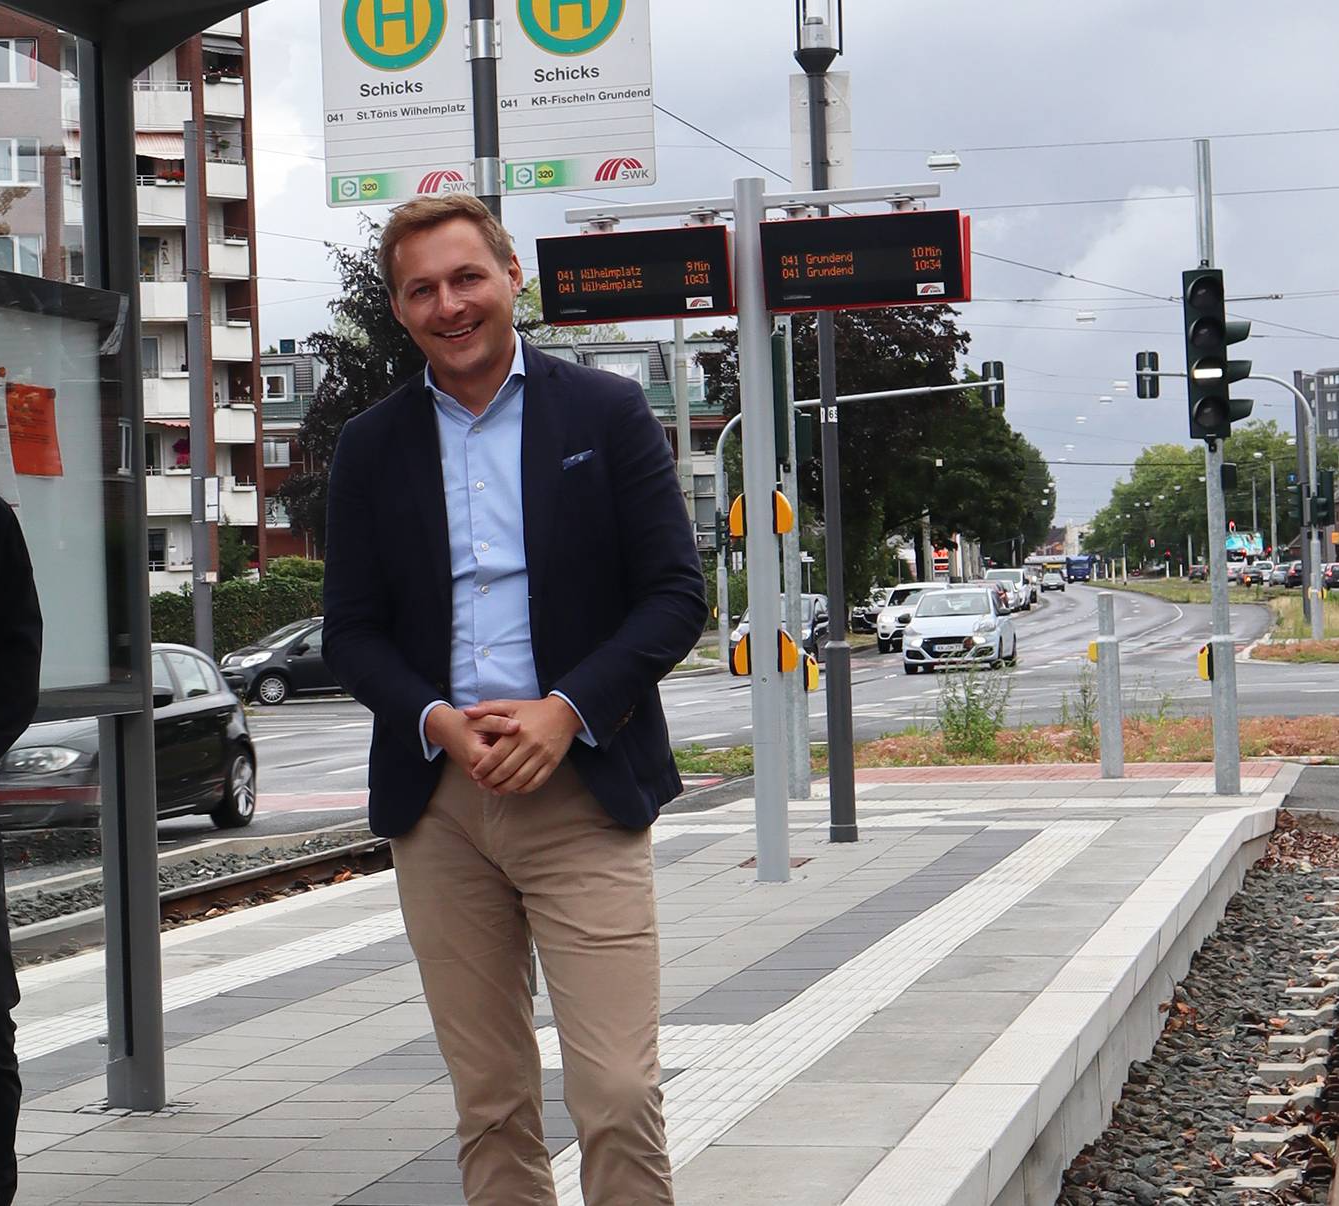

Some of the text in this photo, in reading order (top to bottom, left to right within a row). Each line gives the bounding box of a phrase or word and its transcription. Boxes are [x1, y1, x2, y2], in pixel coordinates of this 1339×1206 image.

[534, 65, 600, 83] Schicks
[360, 80, 423, 97] Schicks
[500, 88, 651, 109] 041 KR-Fischeln Grundend
[327, 113, 344, 123] 041
[400, 104, 466, 117] Wilhelmplatz
[537, 169, 554, 179] 320
[621, 169, 650, 180] SWK
[362, 183, 378, 192] 320
[443, 182, 470, 193] SWK
[781, 255, 798, 266] 041
[806, 253, 853, 264] Grundend
[557, 270, 574, 281] 041
[581, 266, 642, 279] Wilhelmplatz
[782, 259, 941, 279] 041 Grundend 10:34
[558, 283, 575, 294] 041
[582, 279, 643, 292] Wilhelmplatz
